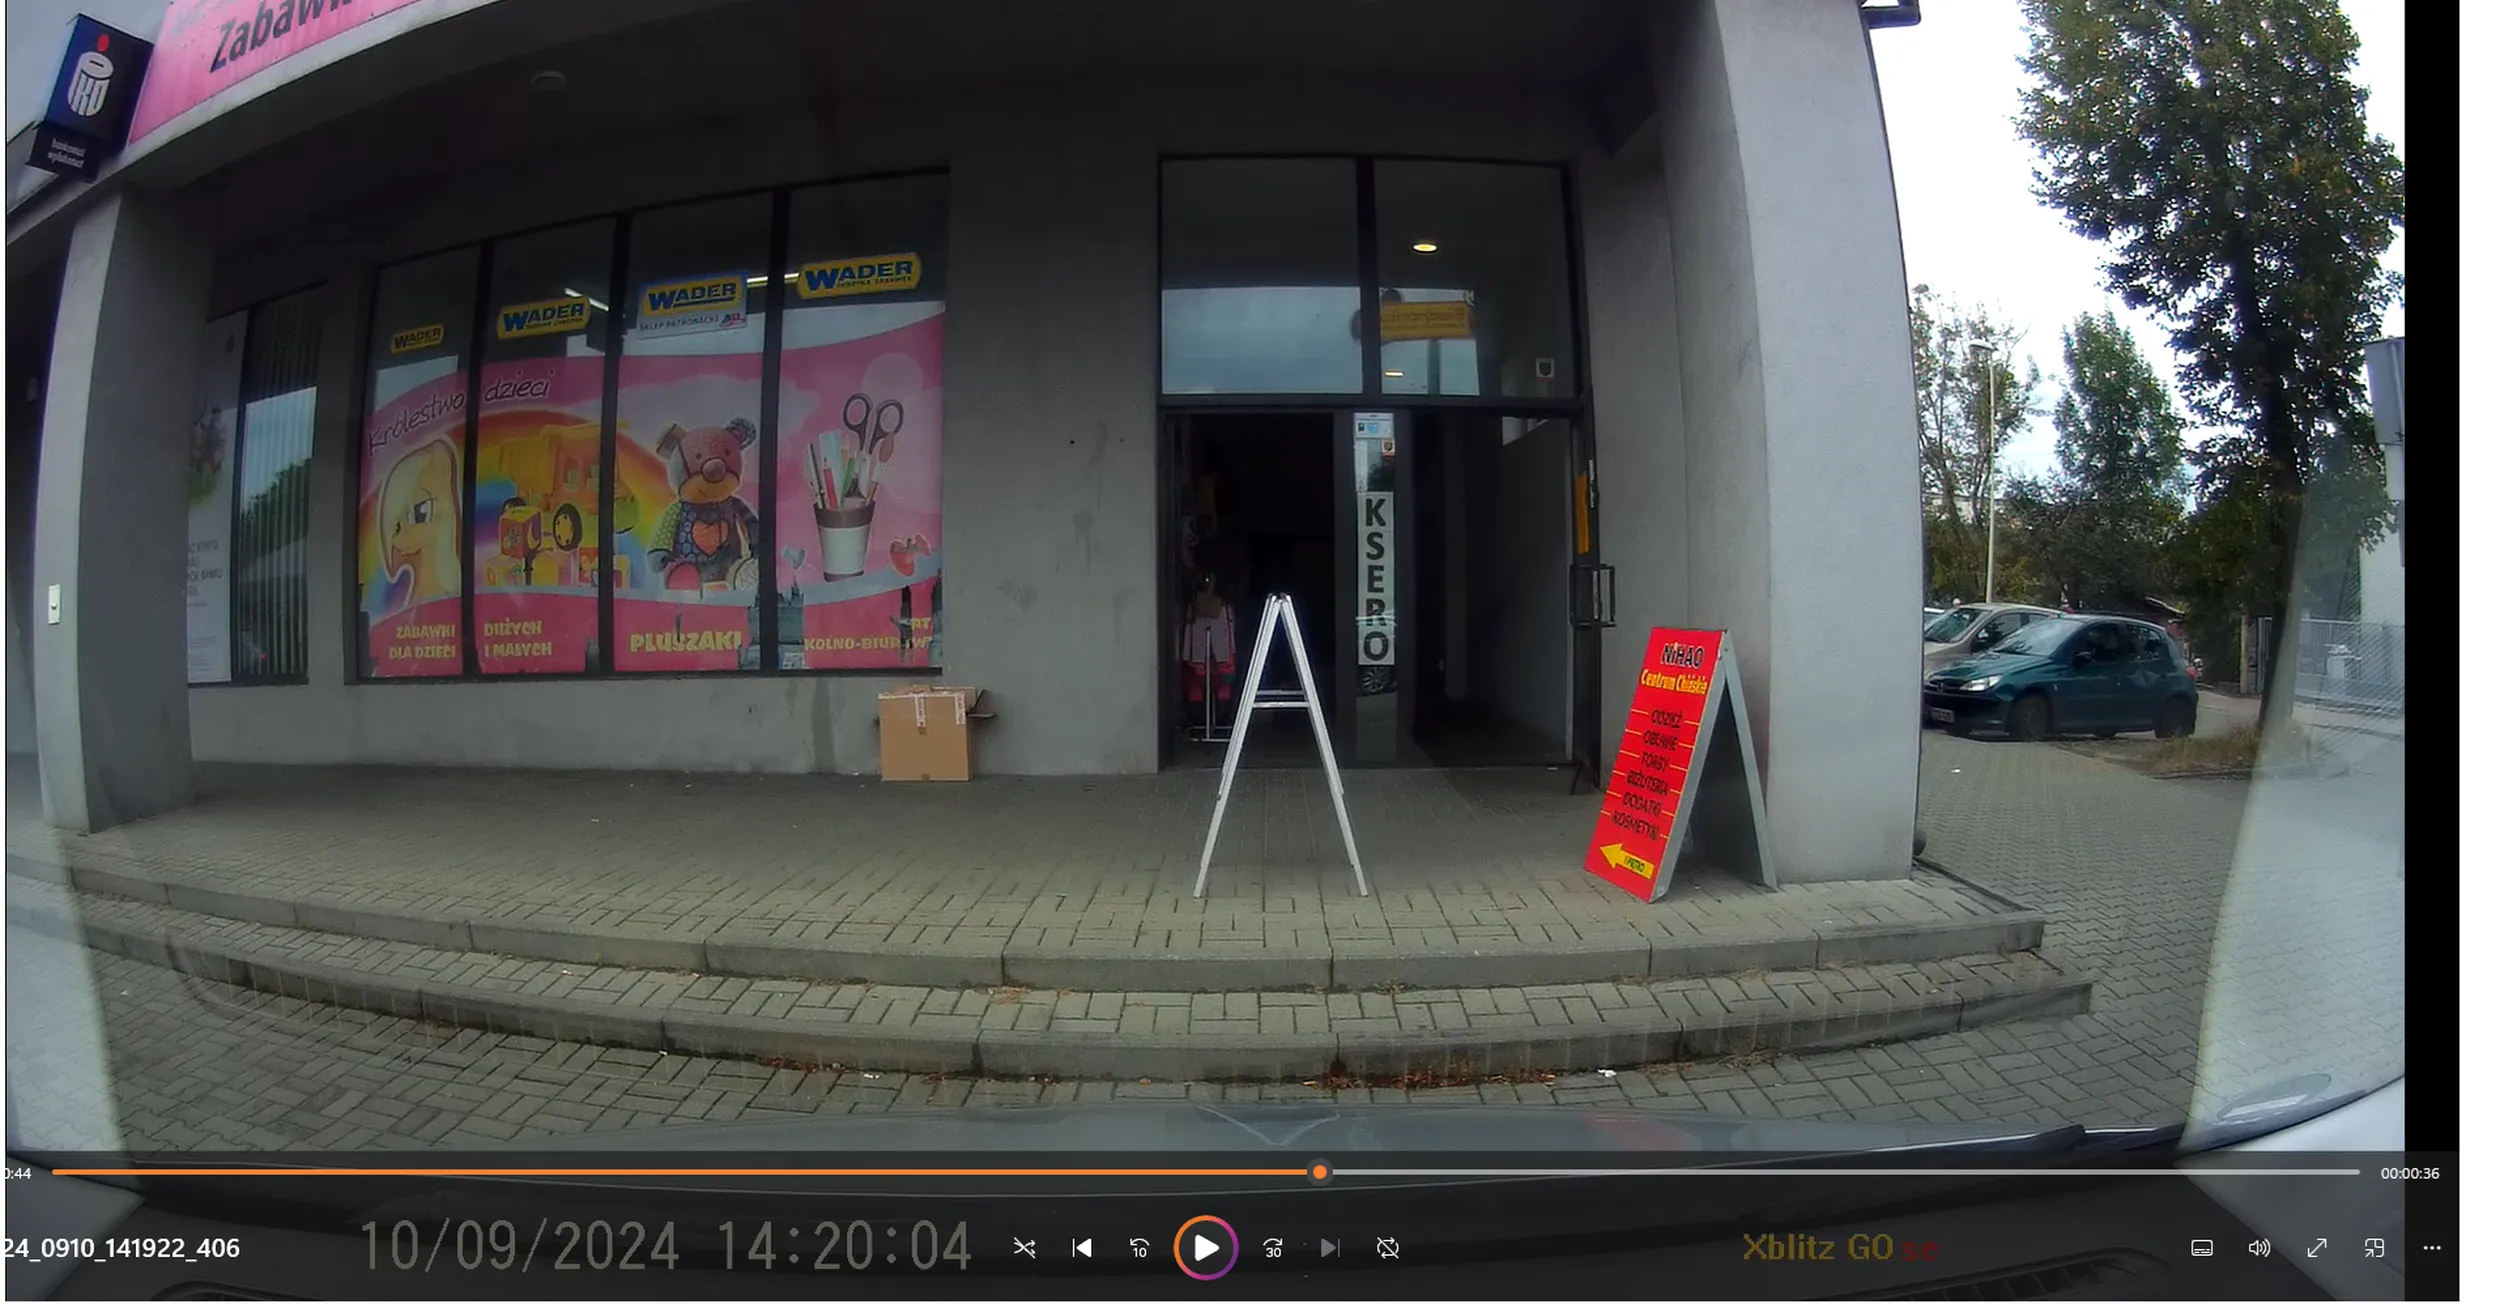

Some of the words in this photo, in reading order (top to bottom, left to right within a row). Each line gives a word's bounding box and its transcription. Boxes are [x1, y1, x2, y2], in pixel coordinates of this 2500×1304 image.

[804, 260, 914, 291] WADER
[647, 282, 737, 311] WADER
[503, 302, 585, 332] WADER
[394, 327, 441, 349] WADER
[485, 371, 554, 402] dzieci
[1362, 498, 1390, 662] KSERO
[396, 624, 457, 640] ZABAWKI
[483, 617, 542, 638] DUŻYCH
[388, 645, 412, 660] DLA
[414, 644, 457, 660] DZIECI
[484, 644, 490, 659] I
[492, 642, 553, 659] MAŁYCH
[629, 630, 743, 653] PLUSZAKI
[1640, 668, 1676, 691] Centrum
